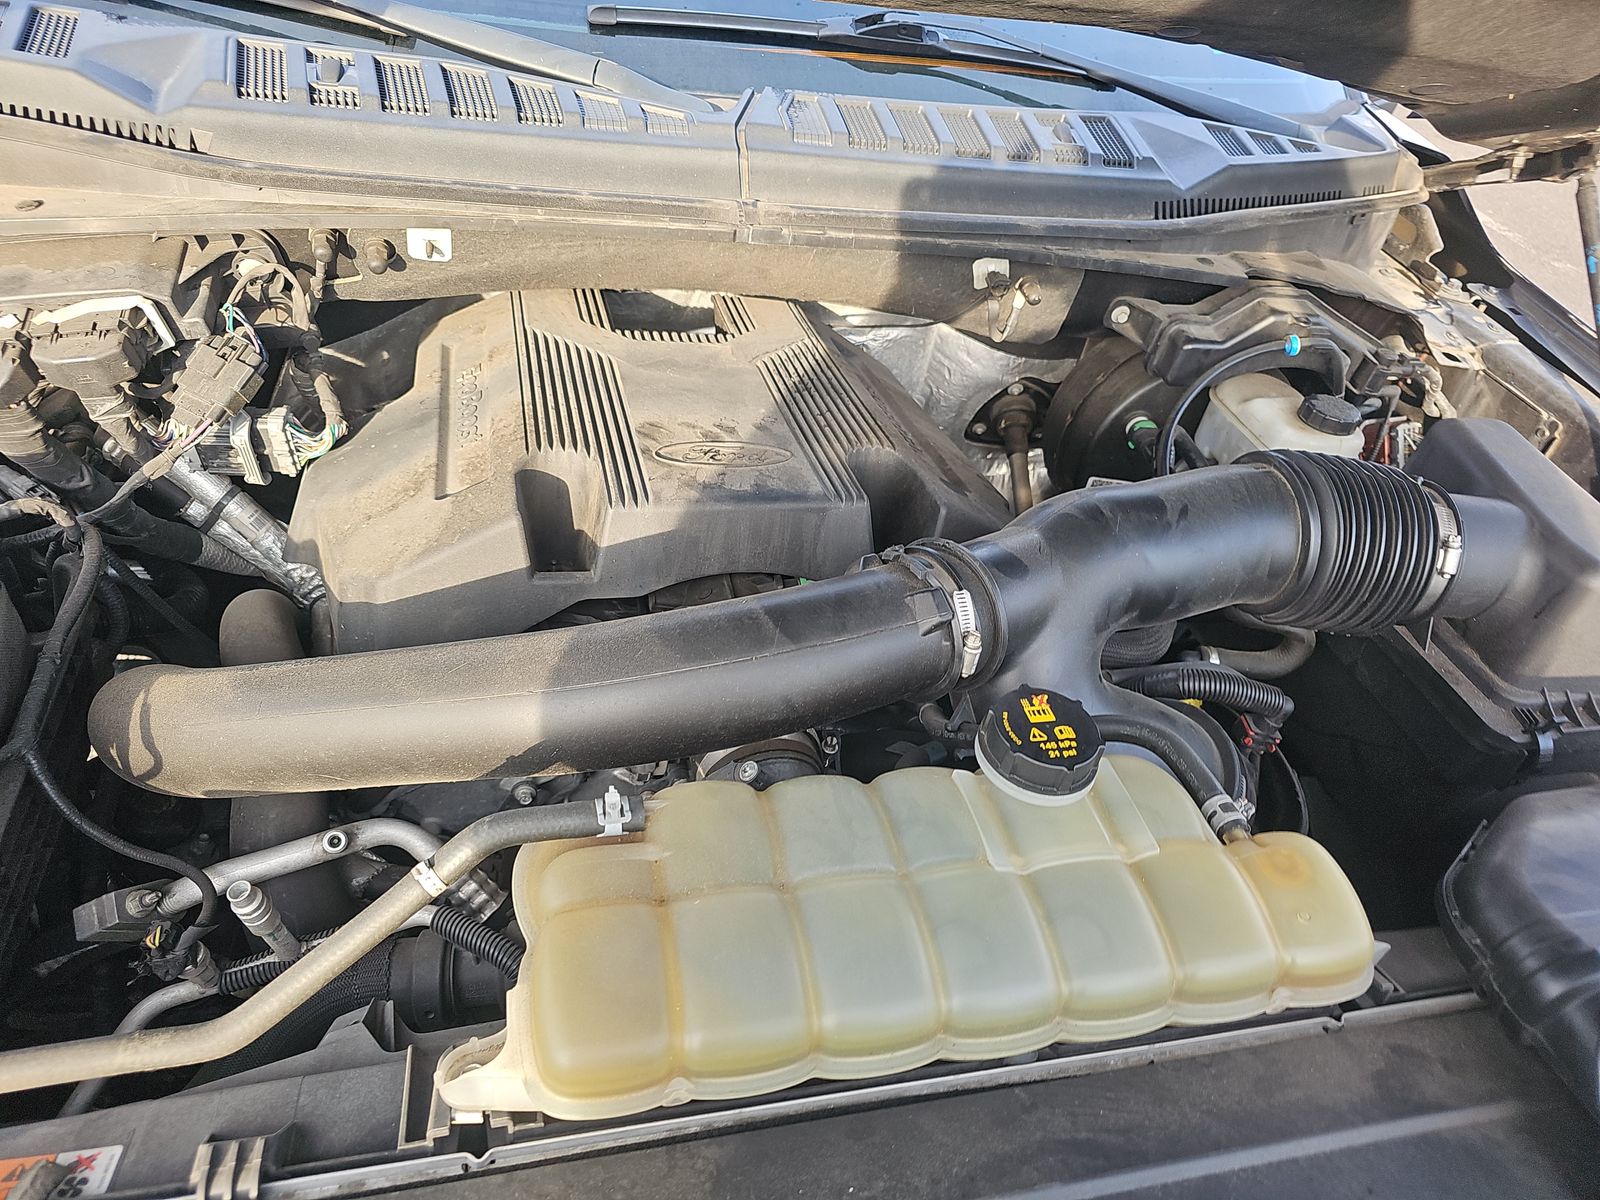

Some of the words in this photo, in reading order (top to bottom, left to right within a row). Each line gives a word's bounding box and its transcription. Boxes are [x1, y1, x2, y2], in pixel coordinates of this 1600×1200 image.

[681, 444, 768, 463] Ford
[1058, 739, 1078, 749] kPa
[1048, 749, 1061, 759] 21
[1062, 748, 1077, 759] psi
